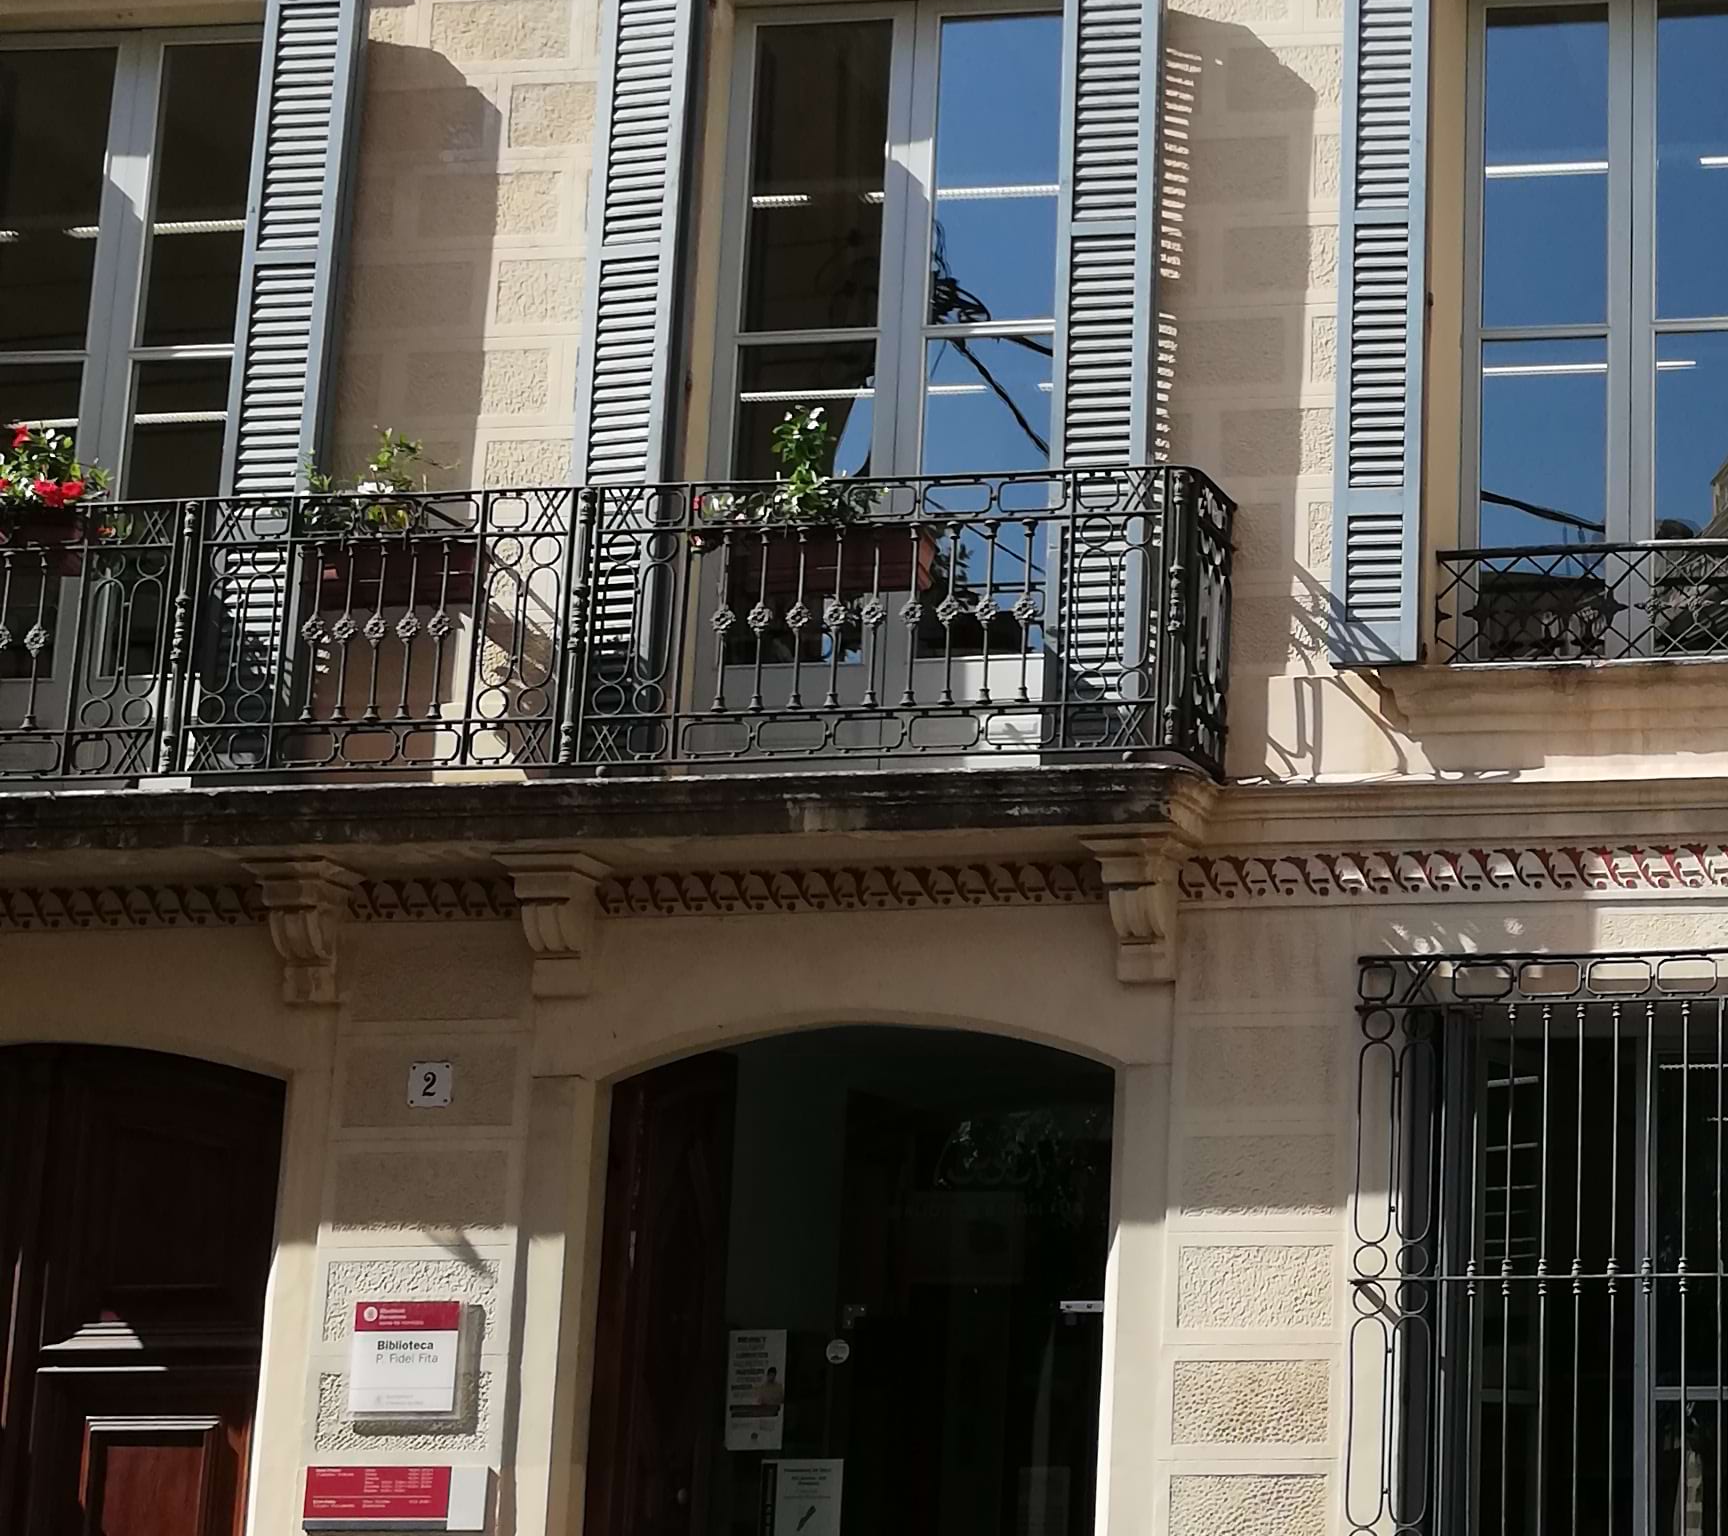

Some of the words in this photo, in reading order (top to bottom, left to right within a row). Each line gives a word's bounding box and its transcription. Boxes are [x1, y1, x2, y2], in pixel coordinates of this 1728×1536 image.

[422, 1072, 436, 1096] 2
[377, 1340, 434, 1350] Biblioteca
[389, 1353, 415, 1363] Fidel
[418, 1353, 438, 1363] Fita
